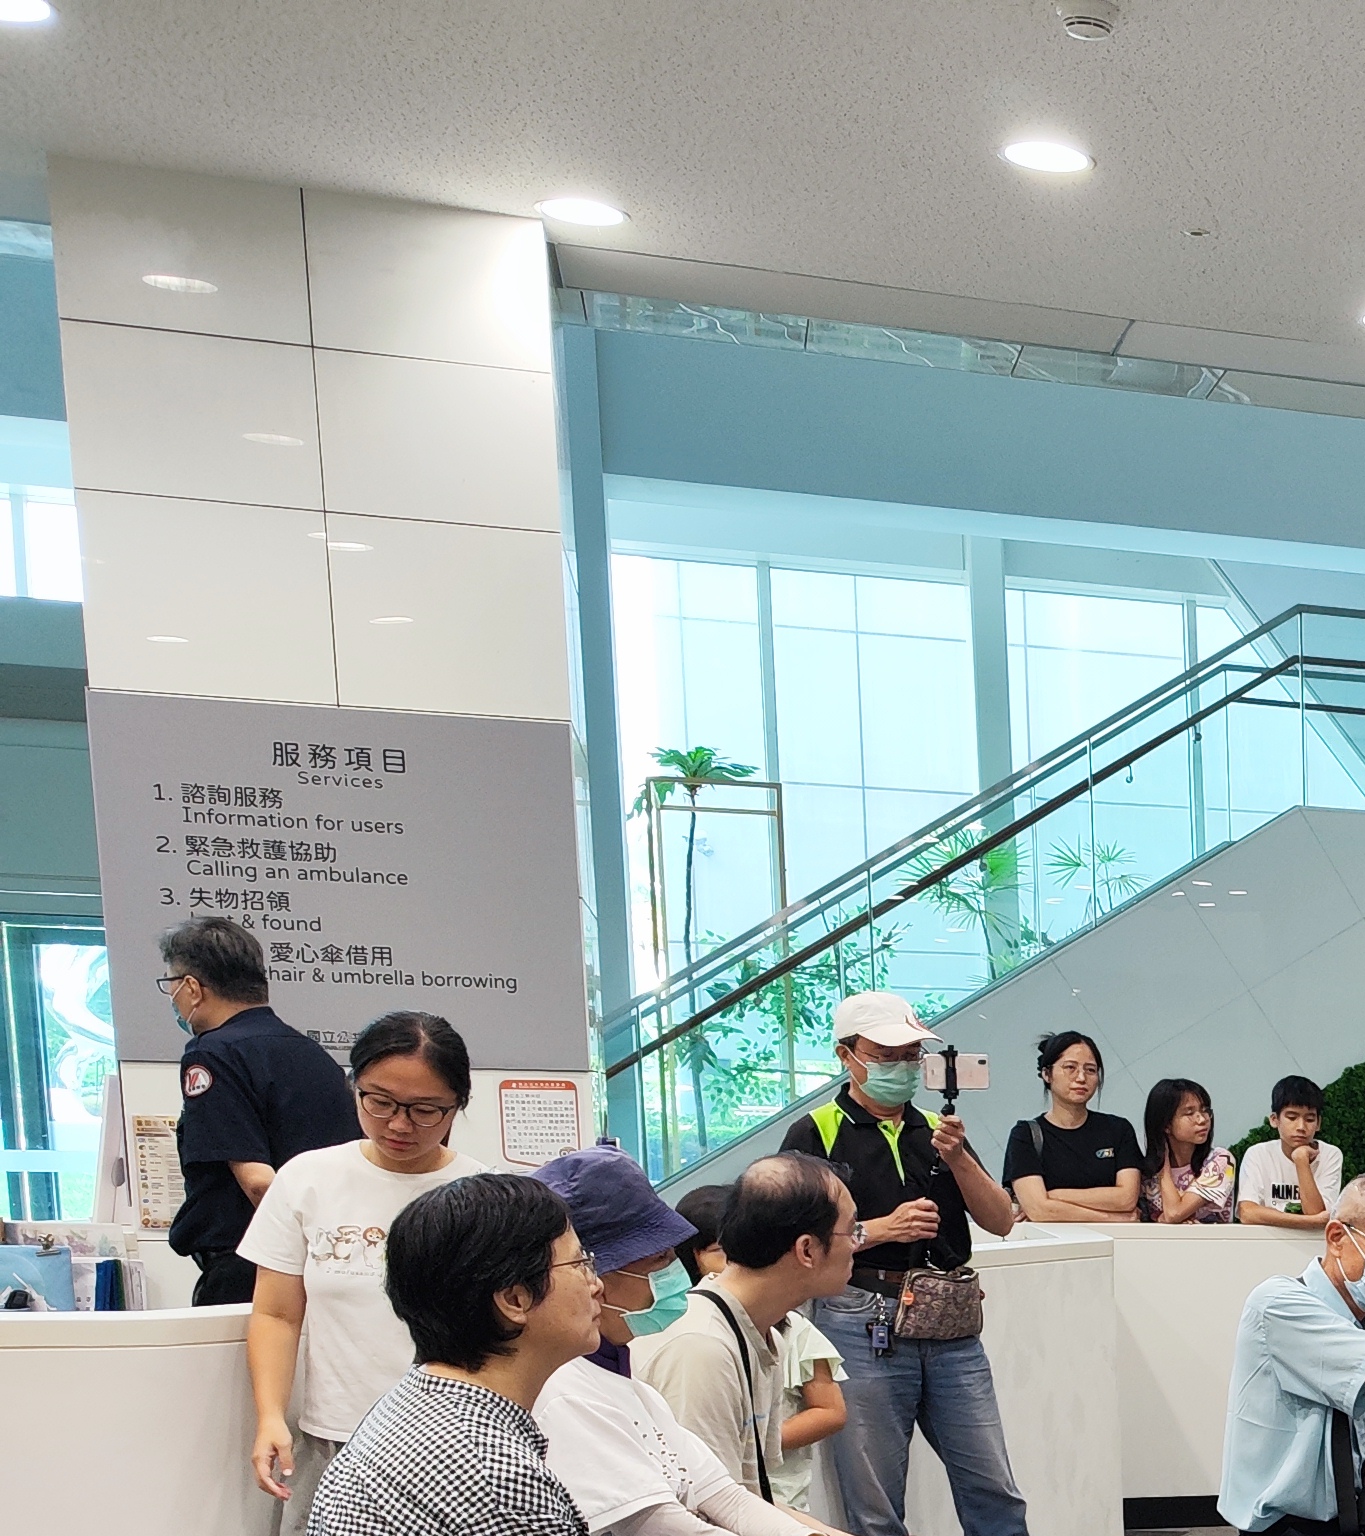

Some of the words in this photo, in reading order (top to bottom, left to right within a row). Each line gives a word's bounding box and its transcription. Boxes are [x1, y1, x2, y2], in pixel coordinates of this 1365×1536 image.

[271, 741, 406, 774] 服務項目
[297, 771, 384, 789] Services
[152, 783, 173, 801] 1.
[180, 782, 284, 809] 諮詢服務
[182, 806, 309, 830] Information
[315, 814, 344, 831] for
[351, 819, 404, 834] users
[155, 836, 177, 854] 2.
[185, 835, 337, 863] 緊急救護協助
[186, 860, 258, 882] Calling
[265, 866, 290, 880] an
[297, 866, 409, 886] ambulance
[160, 887, 181, 905] 3.
[189, 887, 291, 912] 失物招領
[242, 914, 255, 929] &
[261, 914, 322, 932] found
[270, 942, 393, 966] 愛心傘借用
[312, 968, 325, 983] &
[331, 969, 415, 986] umbrella
[421, 971, 518, 993] borrowing
